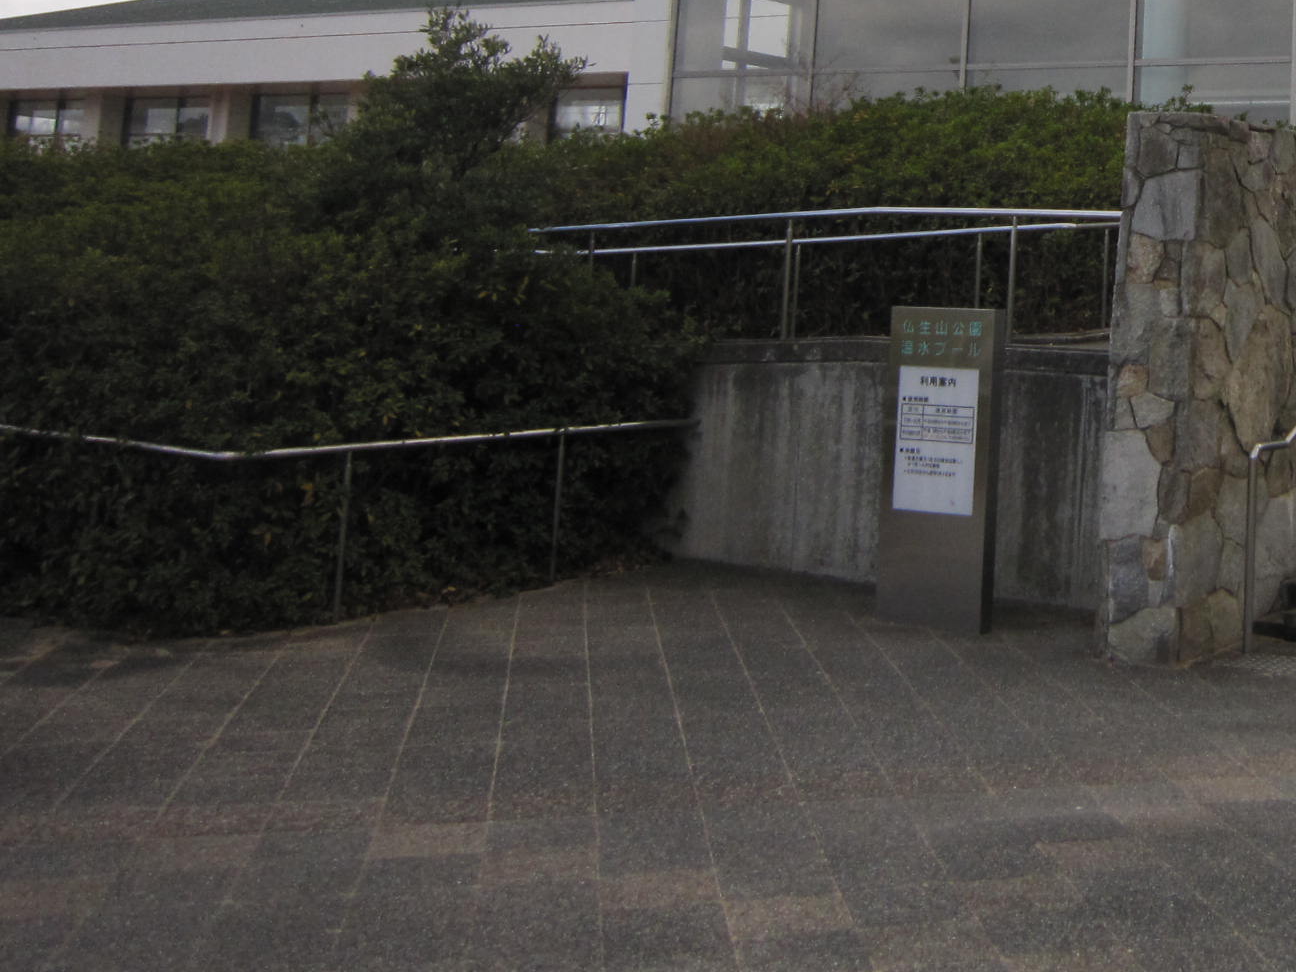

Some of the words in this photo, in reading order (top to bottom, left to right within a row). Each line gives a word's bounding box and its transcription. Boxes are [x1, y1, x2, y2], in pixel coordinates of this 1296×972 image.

[903, 320, 982, 336] 仏生山公園
[901, 340, 982, 357] 温水プール
[920, 375, 957, 387] 利用案内
